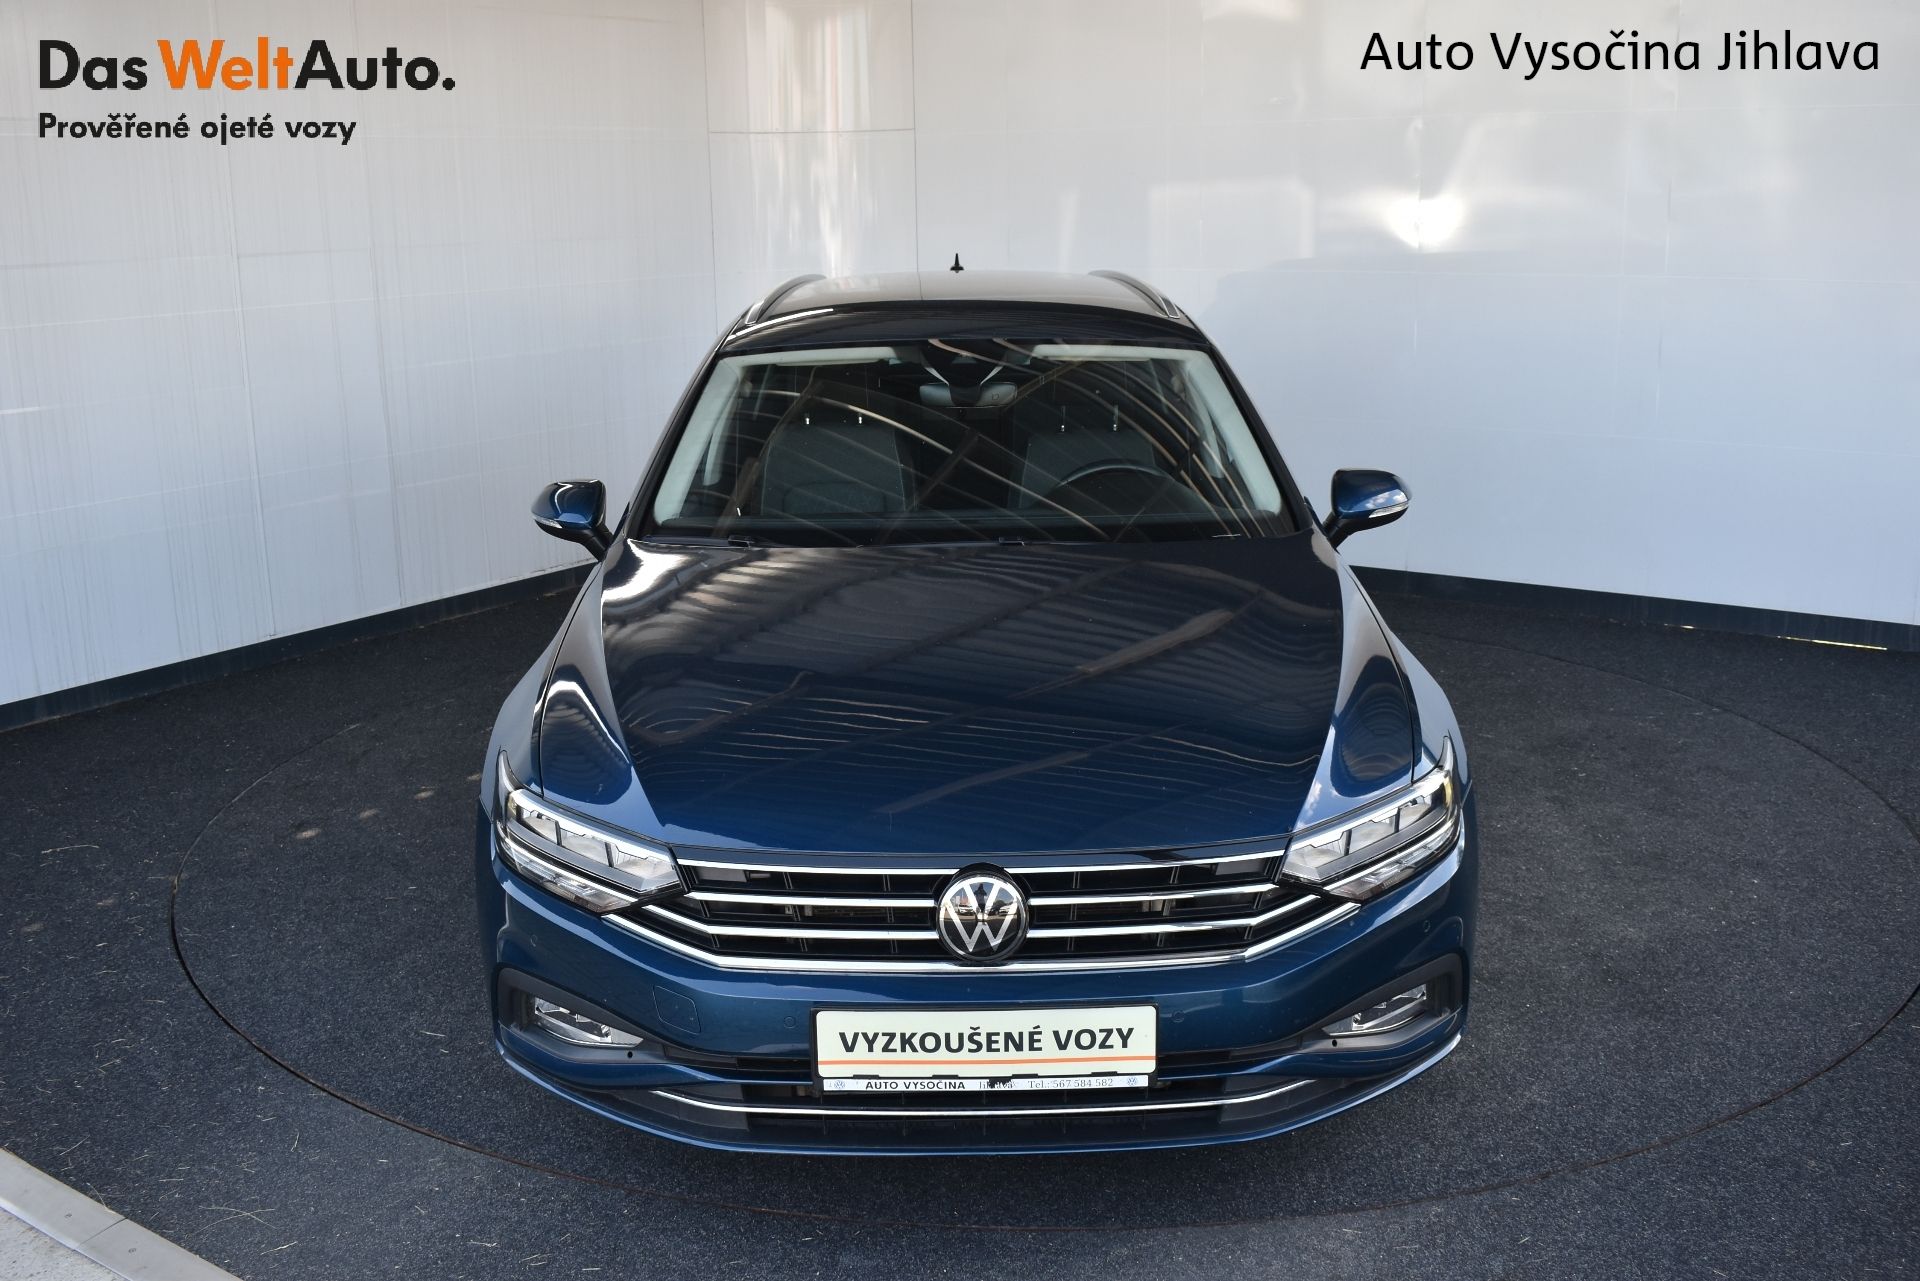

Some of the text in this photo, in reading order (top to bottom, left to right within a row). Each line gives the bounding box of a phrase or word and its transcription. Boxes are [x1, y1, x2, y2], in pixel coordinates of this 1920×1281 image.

[839, 1024, 1135, 1053] VYZKOUŠENÉ VOZY
[865, 1081, 899, 1090] AUTO
[903, 1080, 966, 1090] VYSOČINA
[1053, 1079, 1071, 1088] 567
[1074, 1079, 1092, 1087] 584
[1096, 1078, 1113, 1087] 582
